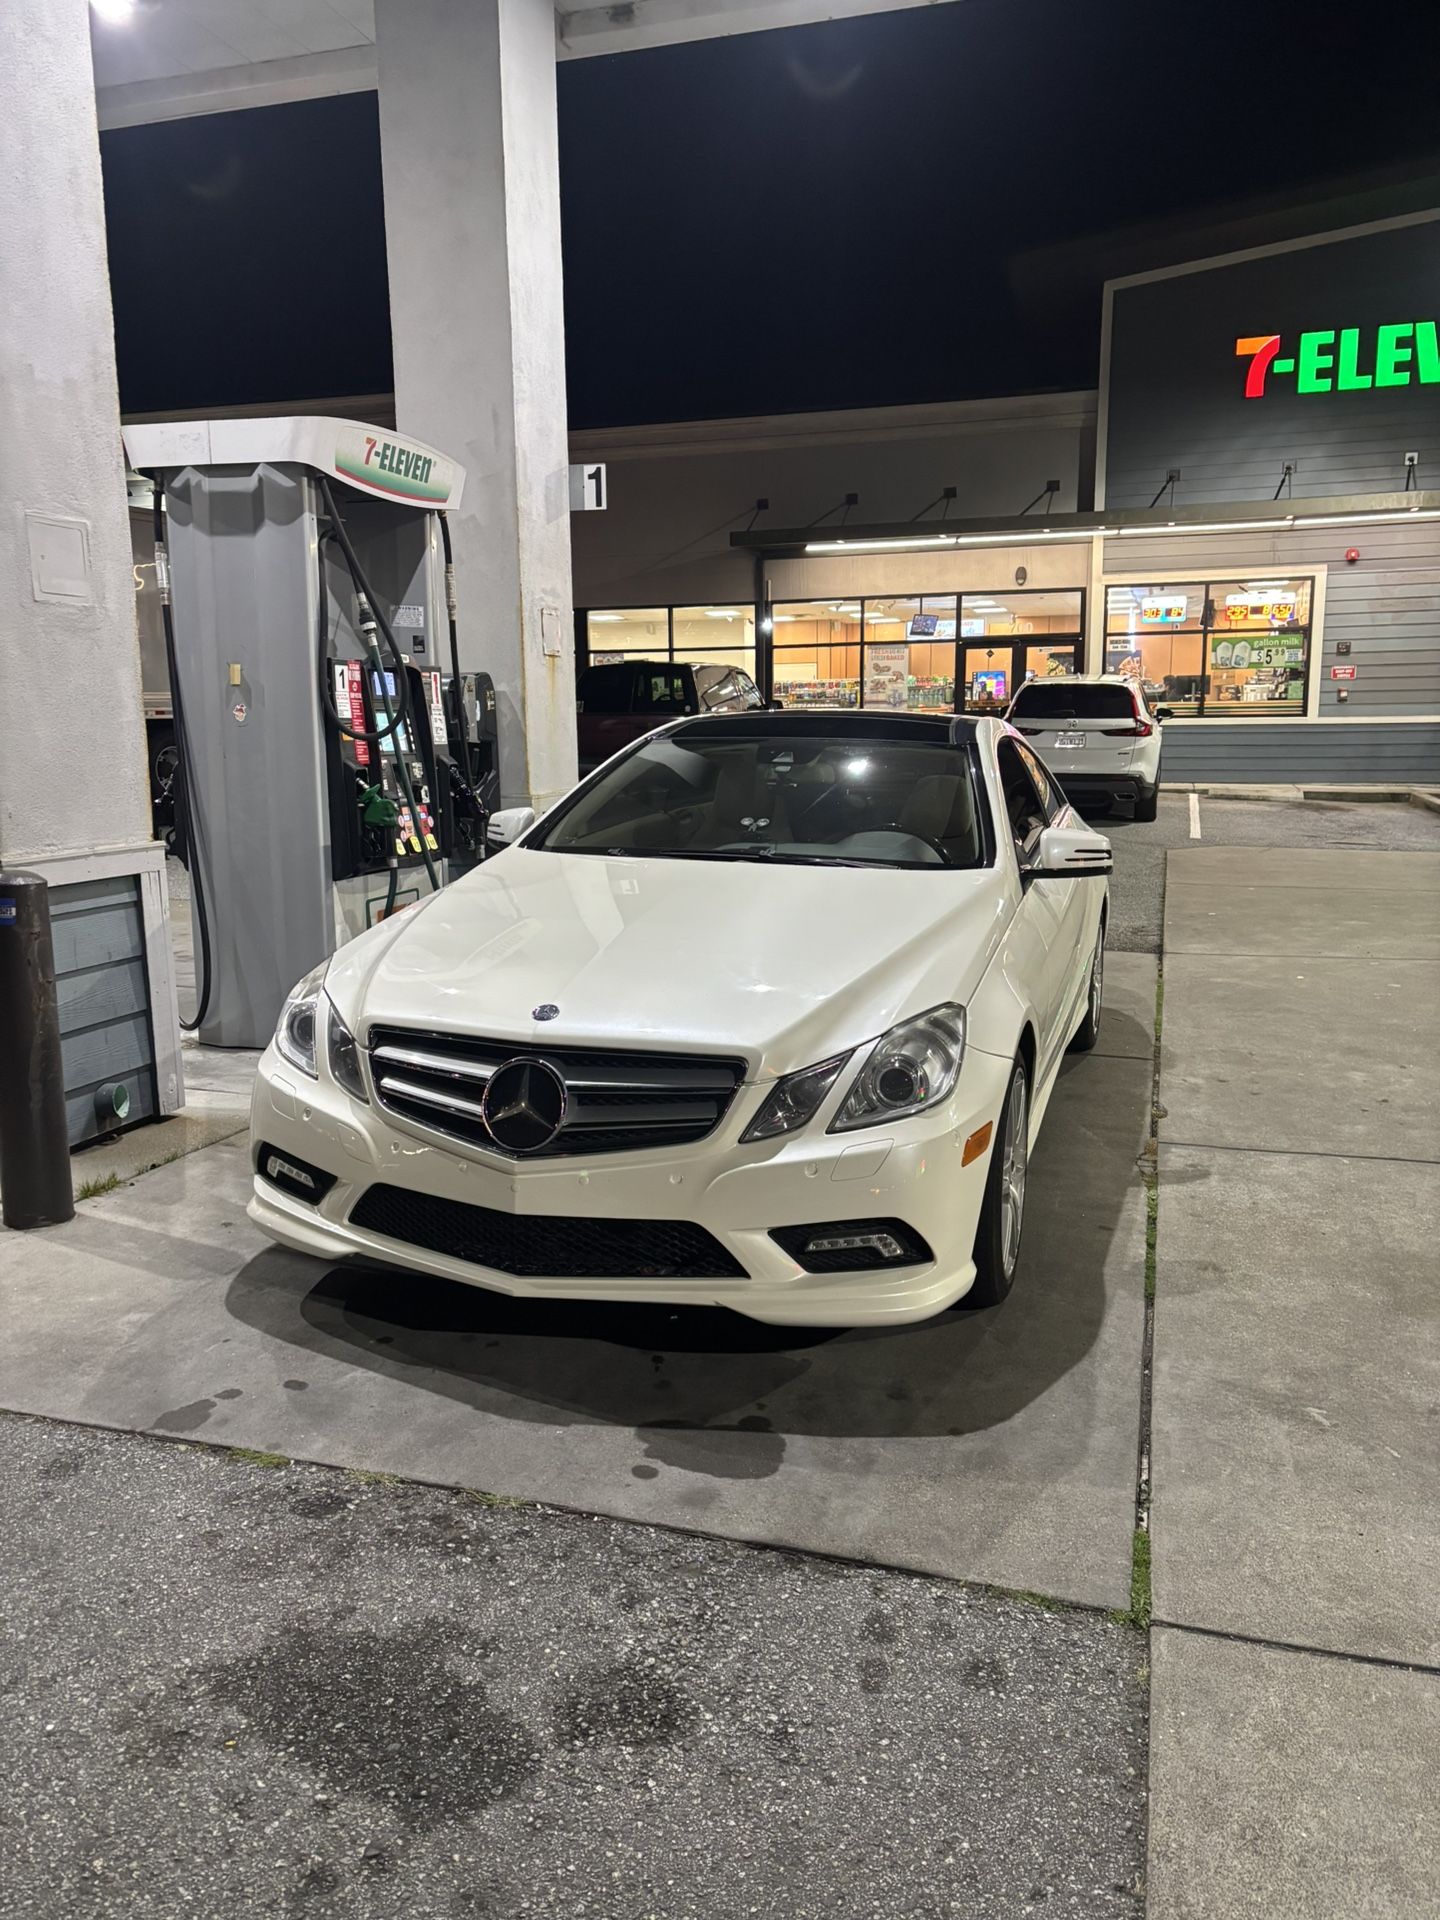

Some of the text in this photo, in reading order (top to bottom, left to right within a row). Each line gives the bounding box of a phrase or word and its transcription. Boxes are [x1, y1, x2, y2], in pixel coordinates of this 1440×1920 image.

[588, 466, 602, 507] 1
[1226, 606, 1248, 616] 295
[1253, 636, 1300, 648] gallon milk
[339, 668, 346, 689] 1
